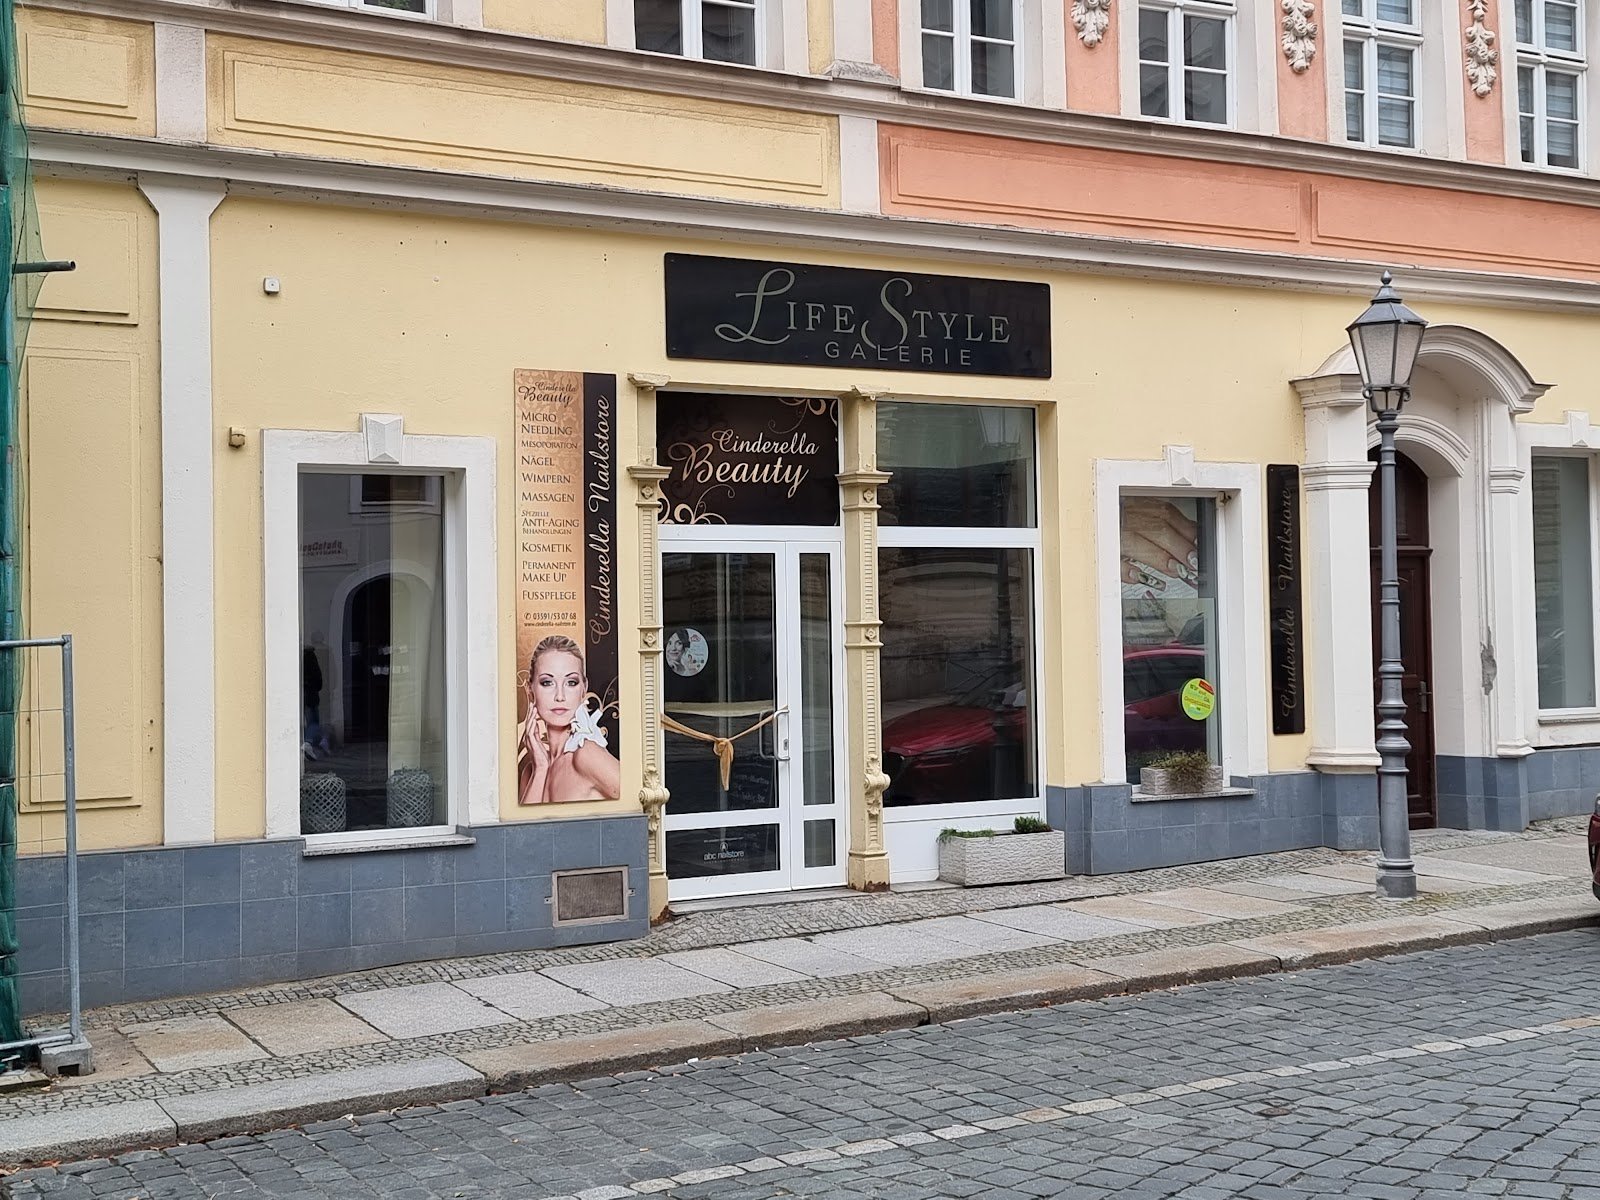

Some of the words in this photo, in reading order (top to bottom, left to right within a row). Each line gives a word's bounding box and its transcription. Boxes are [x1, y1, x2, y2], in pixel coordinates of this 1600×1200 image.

[824, 340, 972, 366] GALERIE
[535, 381, 576, 392] Cinderella
[518, 385, 573, 408] Beauty
[521, 411, 557, 422] MICRO
[521, 424, 573, 436] NEEDLING
[712, 428, 820, 455] Cinderella
[588, 395, 610, 513] Nailstore
[521, 455, 555, 466] NÄGEL
[667, 442, 810, 498] Beauty
[522, 472, 571, 484] WIMPERN
[521, 492, 575, 503] MASSAGEN
[522, 518, 580, 528] ANTI-AGING
[1278, 487, 1294, 591] Nailstore
[521, 542, 573, 553] KOSMETIK
[522, 561, 577, 570] PERMANENT
[522, 572, 551, 583] MAKE
[553, 572, 567, 583] UP
[588, 518, 611, 644] Cinderella
[522, 590, 577, 601] FUSSPFLEGE
[1279, 605, 1297, 717] Cinderella
[703, 852, 717, 860] abc
[718, 850, 745, 859] nailstore
